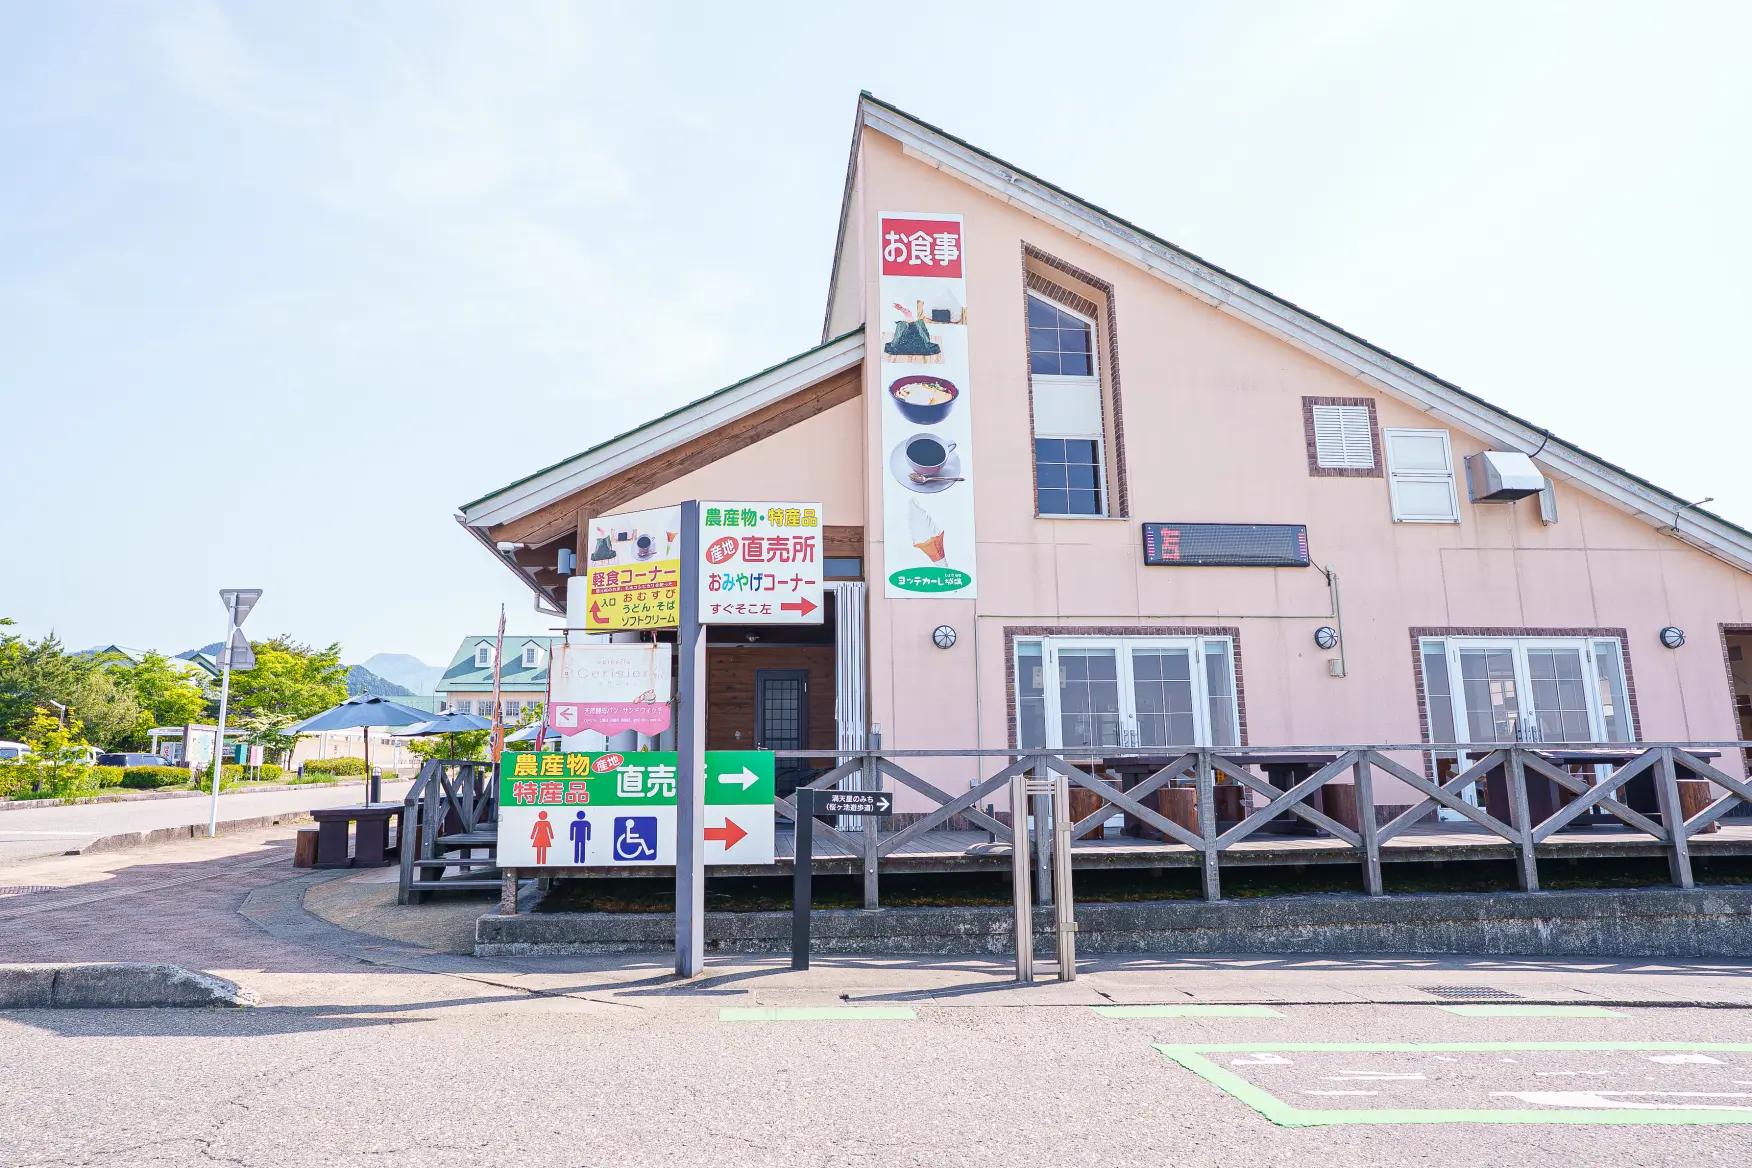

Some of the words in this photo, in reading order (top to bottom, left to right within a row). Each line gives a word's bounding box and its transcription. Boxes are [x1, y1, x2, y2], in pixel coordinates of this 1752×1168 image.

[884, 230, 959, 266] お食事
[705, 508, 818, 527] 農産物・特産品
[710, 539, 736, 563] 産地
[741, 535, 815, 563] 直売所
[592, 566, 676, 587] 軽食コーナー
[708, 572, 815, 592] おみやげコーナー
[601, 598, 616, 607] 入口
[623, 589, 676, 603] おむすび
[623, 601, 676, 614] うどん・そば
[710, 603, 772, 615] すぐそこ左
[621, 613, 676, 626] ソフトクリーム
[513, 753, 591, 777] 農産物
[596, 755, 620, 771] 産地
[512, 780, 590, 804] 特産品
[831, 795, 874, 803] 満天星のみち
